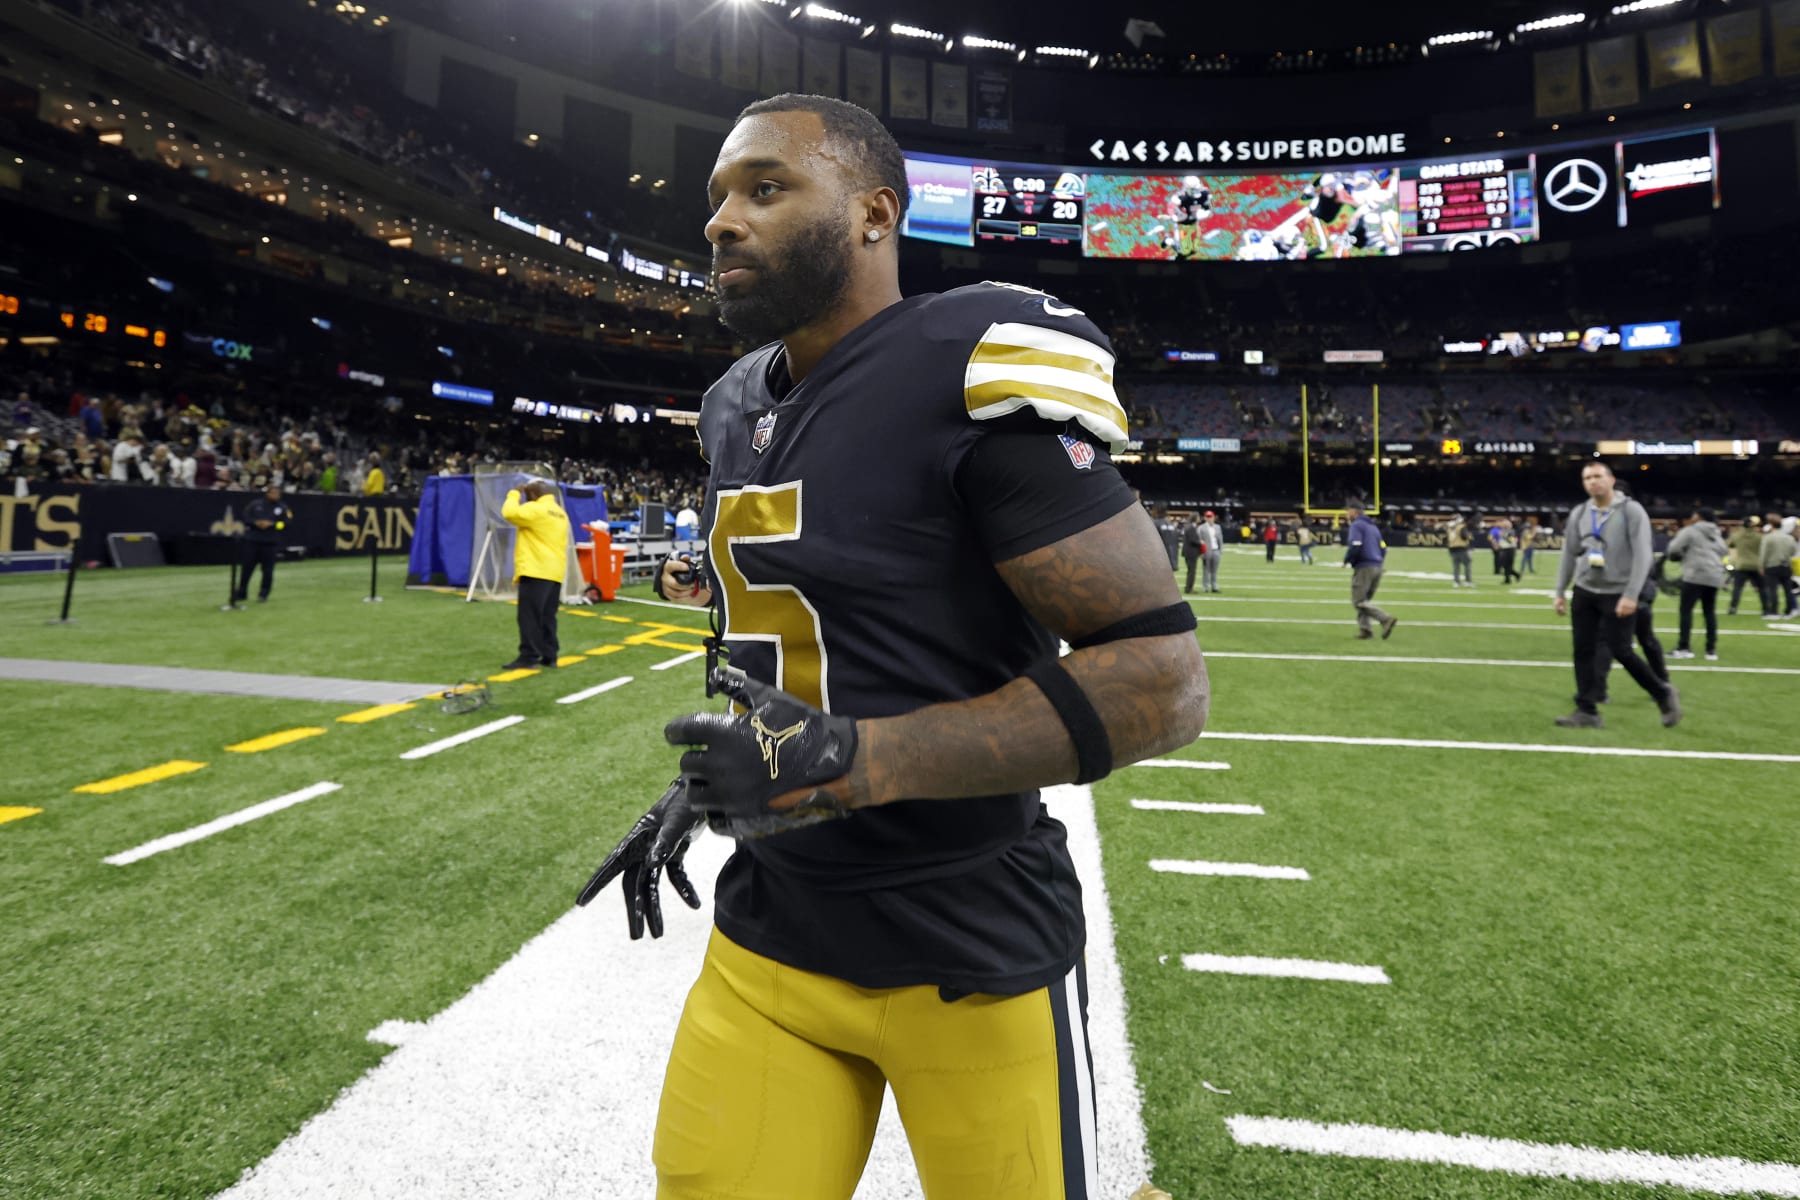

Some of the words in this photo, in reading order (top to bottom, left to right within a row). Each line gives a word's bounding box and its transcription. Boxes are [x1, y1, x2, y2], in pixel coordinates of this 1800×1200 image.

[1089, 139, 1234, 163] CAESARS
[1236, 132, 1407, 161] SUPERDOME
[1420, 165, 1459, 179] GAME
[1460, 159, 1504, 175] STATS
[1012, 177, 1046, 193] 0:00
[982, 196, 1007, 214] 27
[1052, 201, 1078, 220] 20
[212, 338, 253, 361] COX
[1070, 441, 1093, 465] NFL
[709, 480, 831, 716] 5
